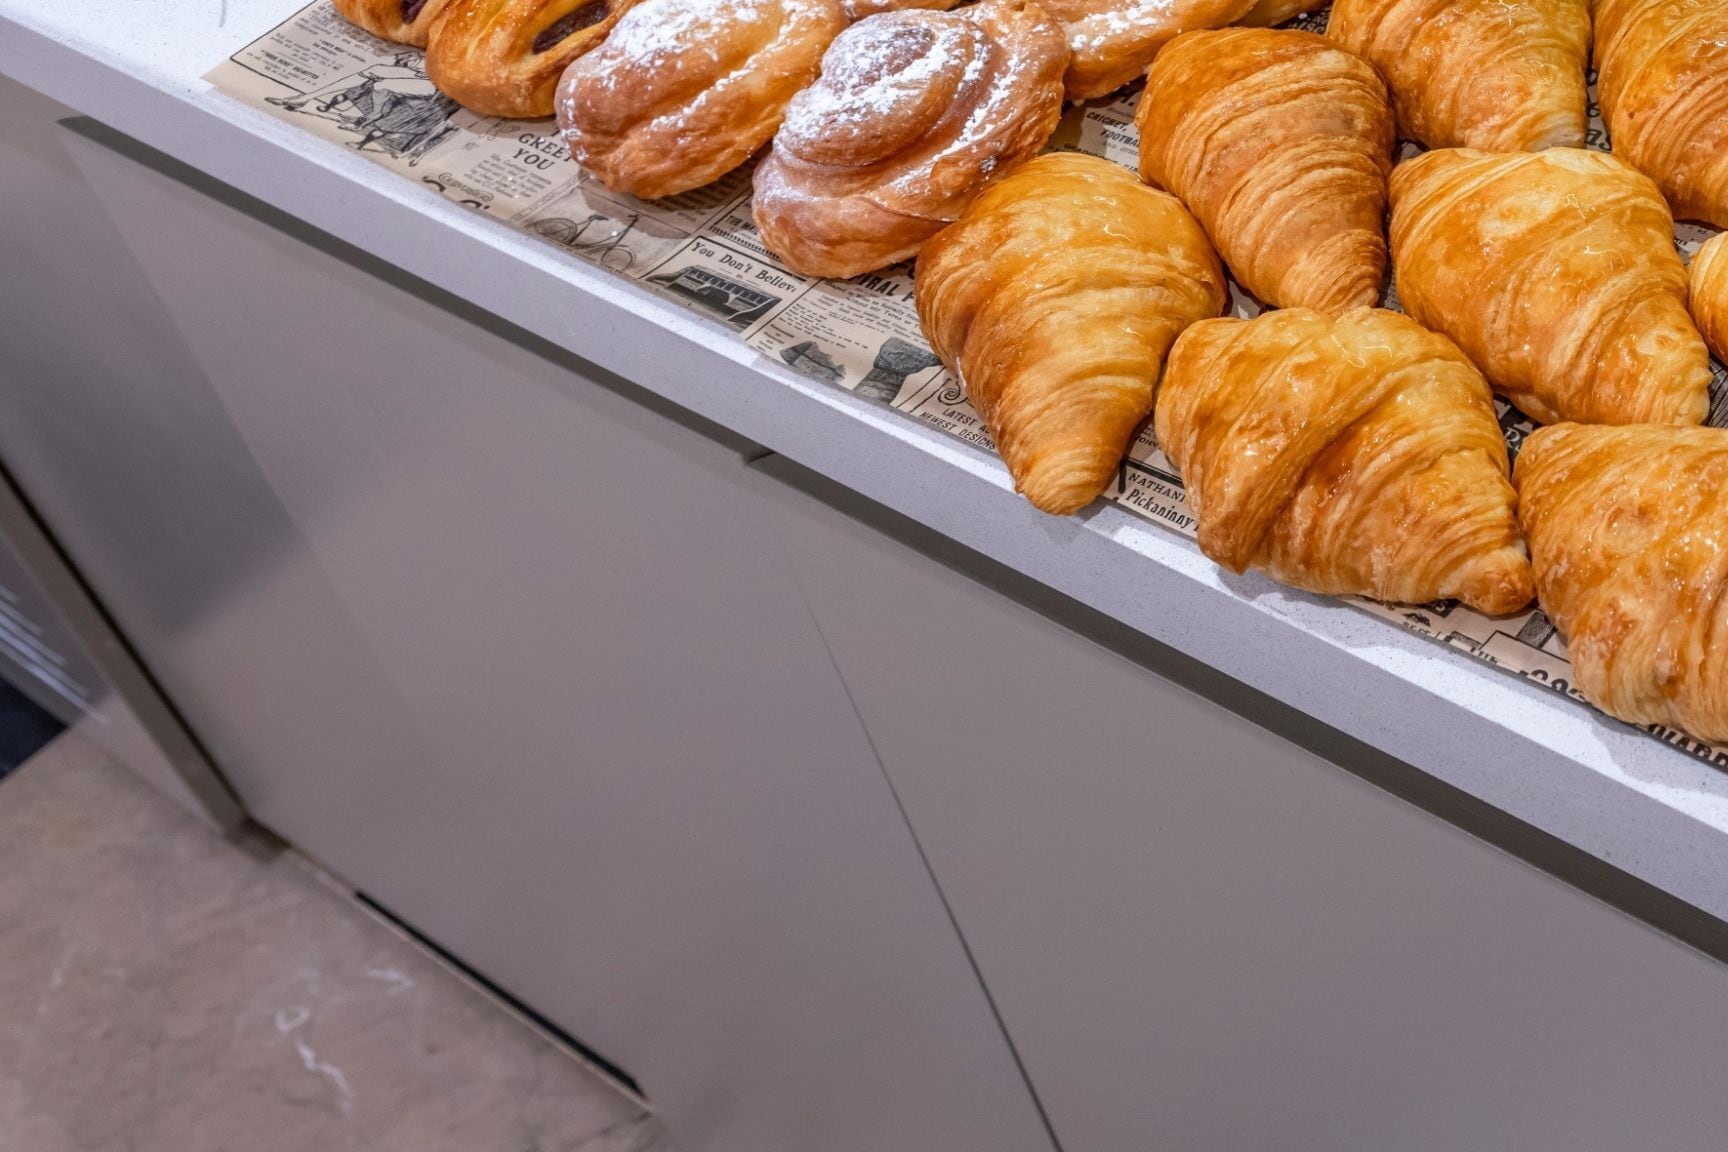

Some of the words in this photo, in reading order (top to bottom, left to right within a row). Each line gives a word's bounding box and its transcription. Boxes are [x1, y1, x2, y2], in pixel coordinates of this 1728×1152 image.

[1086, 111, 1128, 132] CRICKET,
[1100, 129, 1140, 147] FOOTBA
[513, 147, 556, 171] YOU
[691, 241, 717, 258] You
[718, 253, 754, 274] Don't
[755, 269, 798, 294] Believ
[919, 410, 957, 432] NEWEST
[941, 408, 980, 427] LATEST
[1126, 488, 1196, 534] Pickaninny
